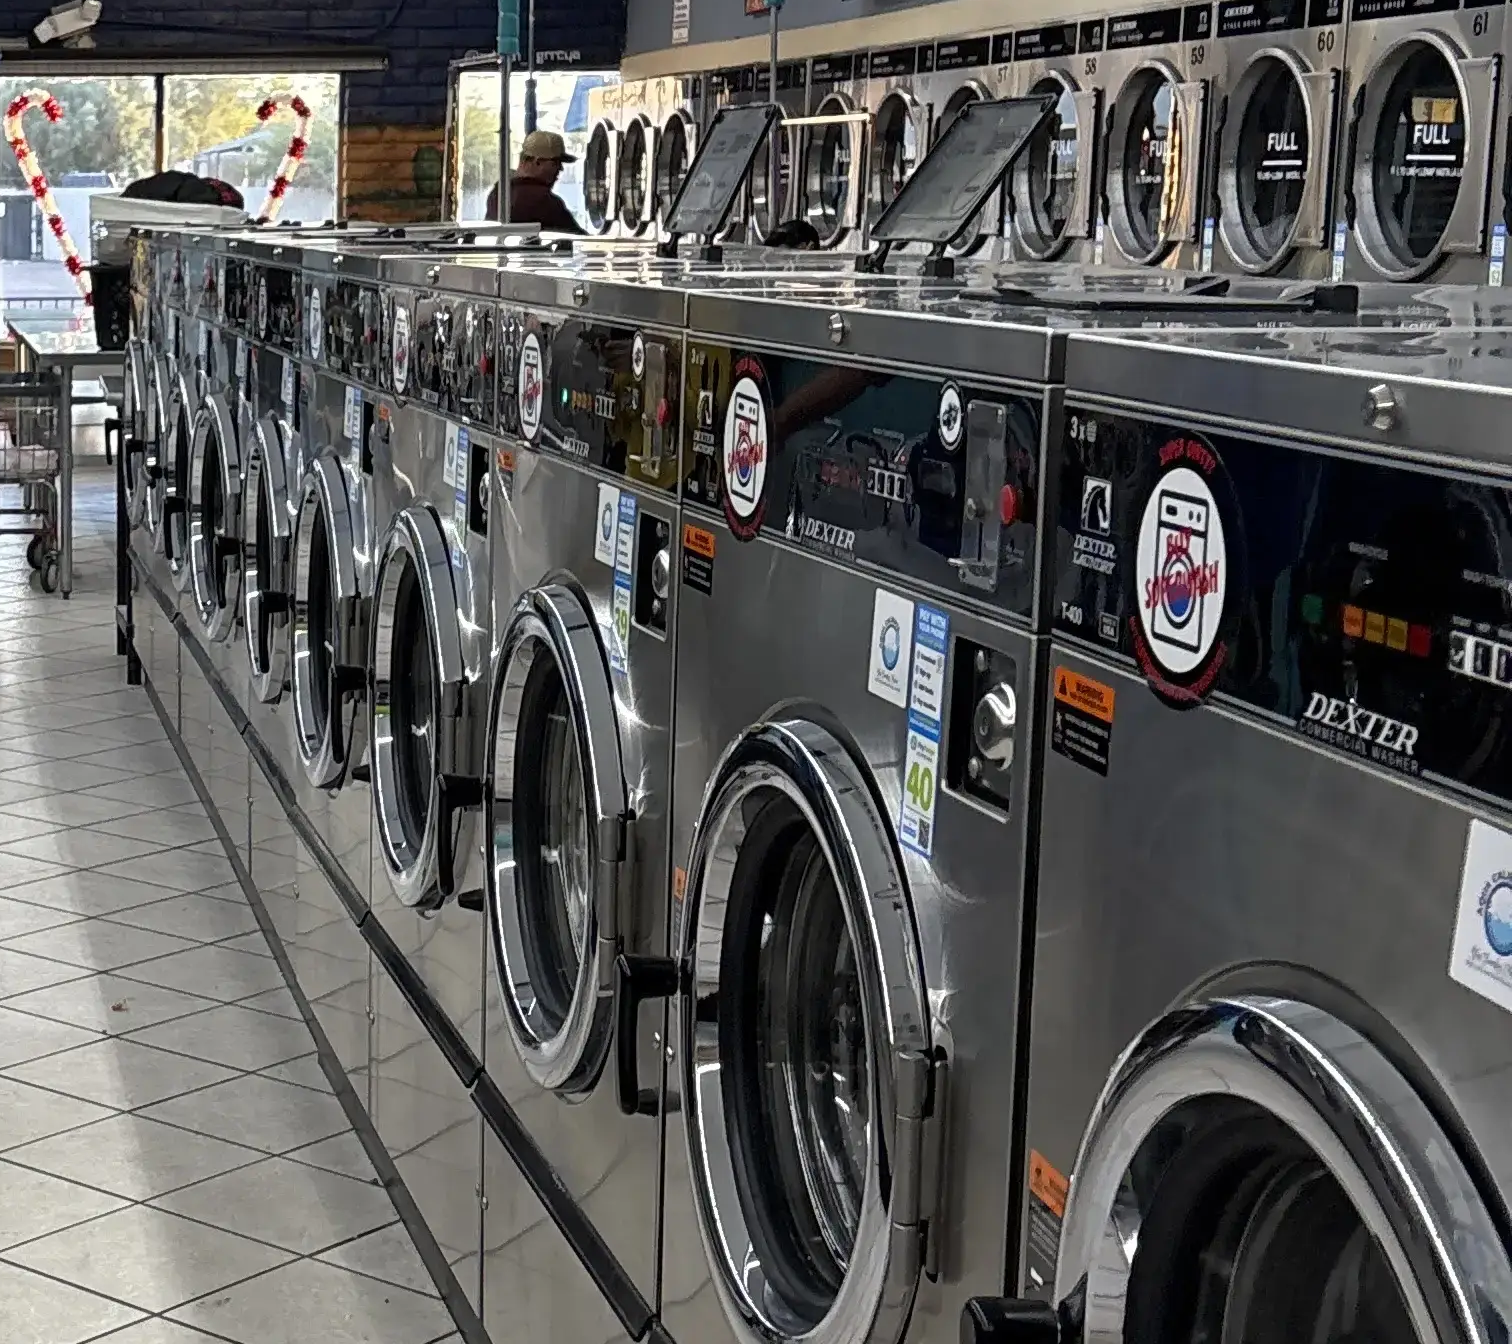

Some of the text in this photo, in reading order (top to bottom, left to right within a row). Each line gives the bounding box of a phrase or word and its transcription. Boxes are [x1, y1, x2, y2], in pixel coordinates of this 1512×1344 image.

[1473, 11, 1489, 36] 61
[1317, 31, 1335, 52] 60
[1190, 45, 1205, 66] 59
[997, 66, 1008, 84] 57
[1084, 58, 1097, 76] 58
[1267, 132, 1298, 151] FULL
[1413, 124, 1450, 145] FULL
[1051, 140, 1073, 155] FULL
[805, 518, 856, 549] DEXTER
[1074, 534, 1116, 558] DEXTER
[1303, 691, 1419, 755] DEXTER
[1299, 719, 1419, 775] COMMERCIAL WASHER
[906, 761, 934, 813] 40
